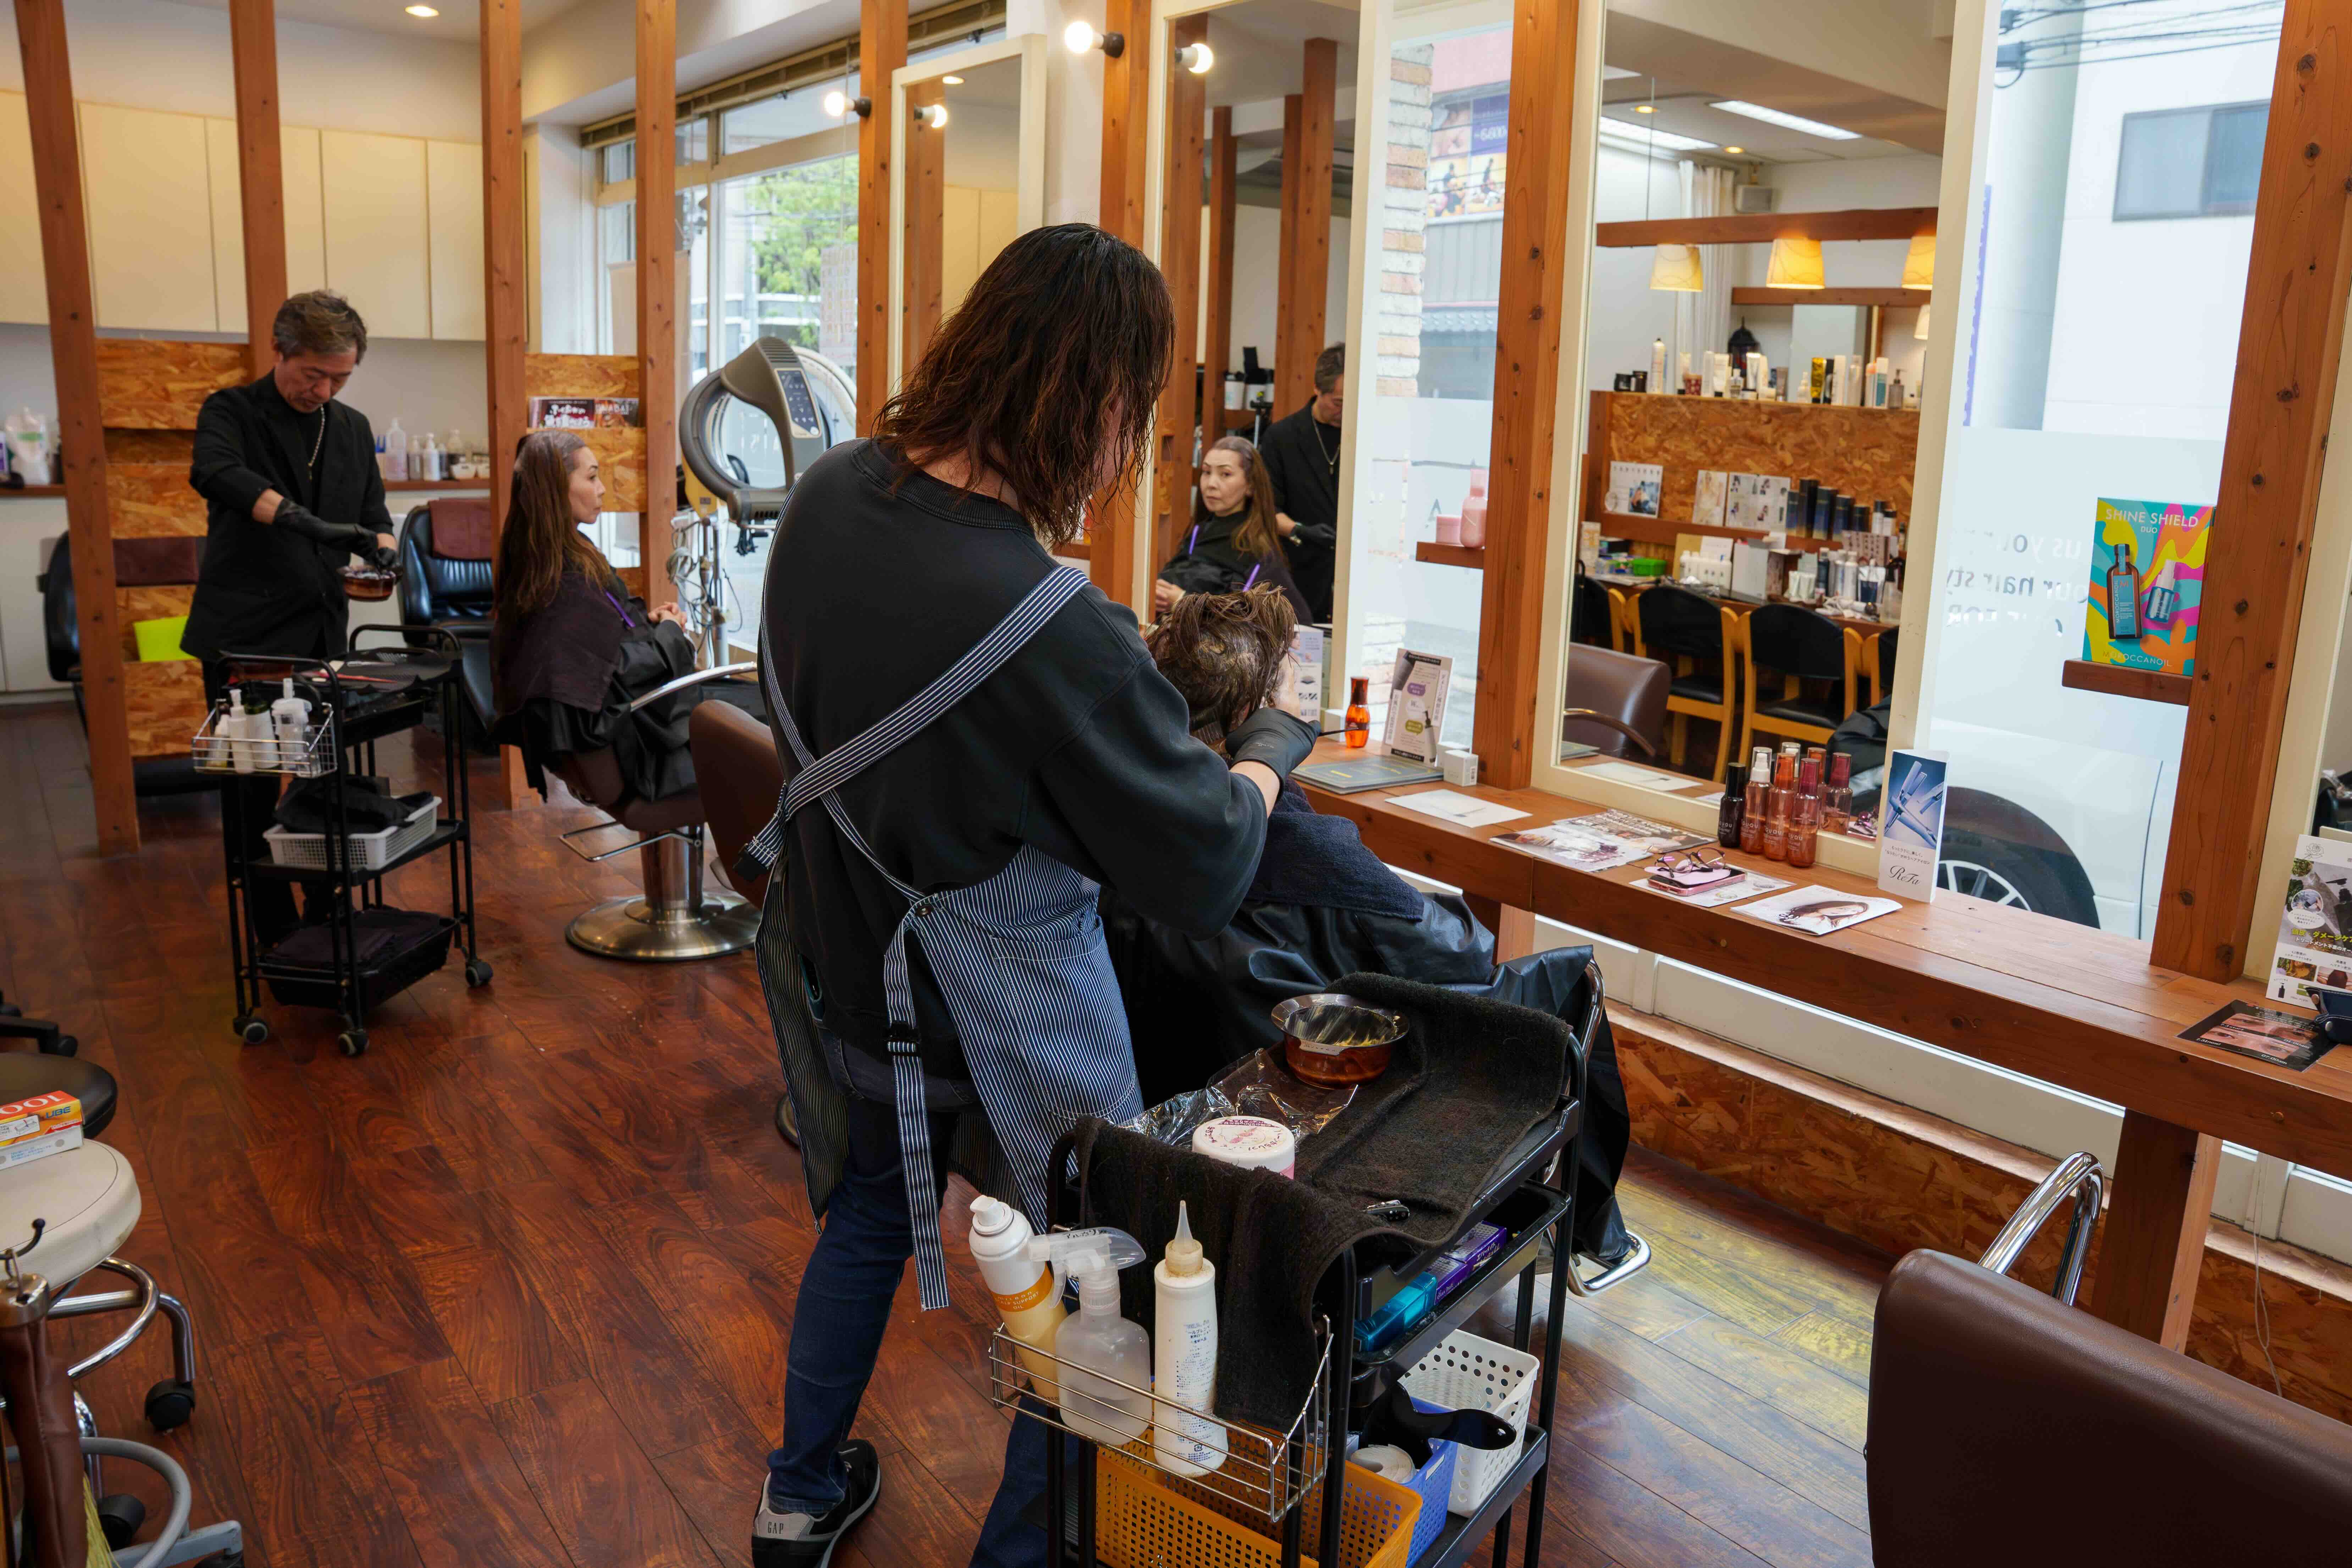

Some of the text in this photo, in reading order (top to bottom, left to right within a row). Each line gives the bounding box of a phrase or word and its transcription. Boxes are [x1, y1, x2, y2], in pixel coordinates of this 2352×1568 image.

[2106, 509, 2198, 528] SHINE SHIELD
[2103, 650, 2172, 667] MOROCCANOIL
[1888, 865, 1921, 885] ReFa
[46, 1106, 71, 1119] UBE
[767, 1521, 784, 1534] GAP
